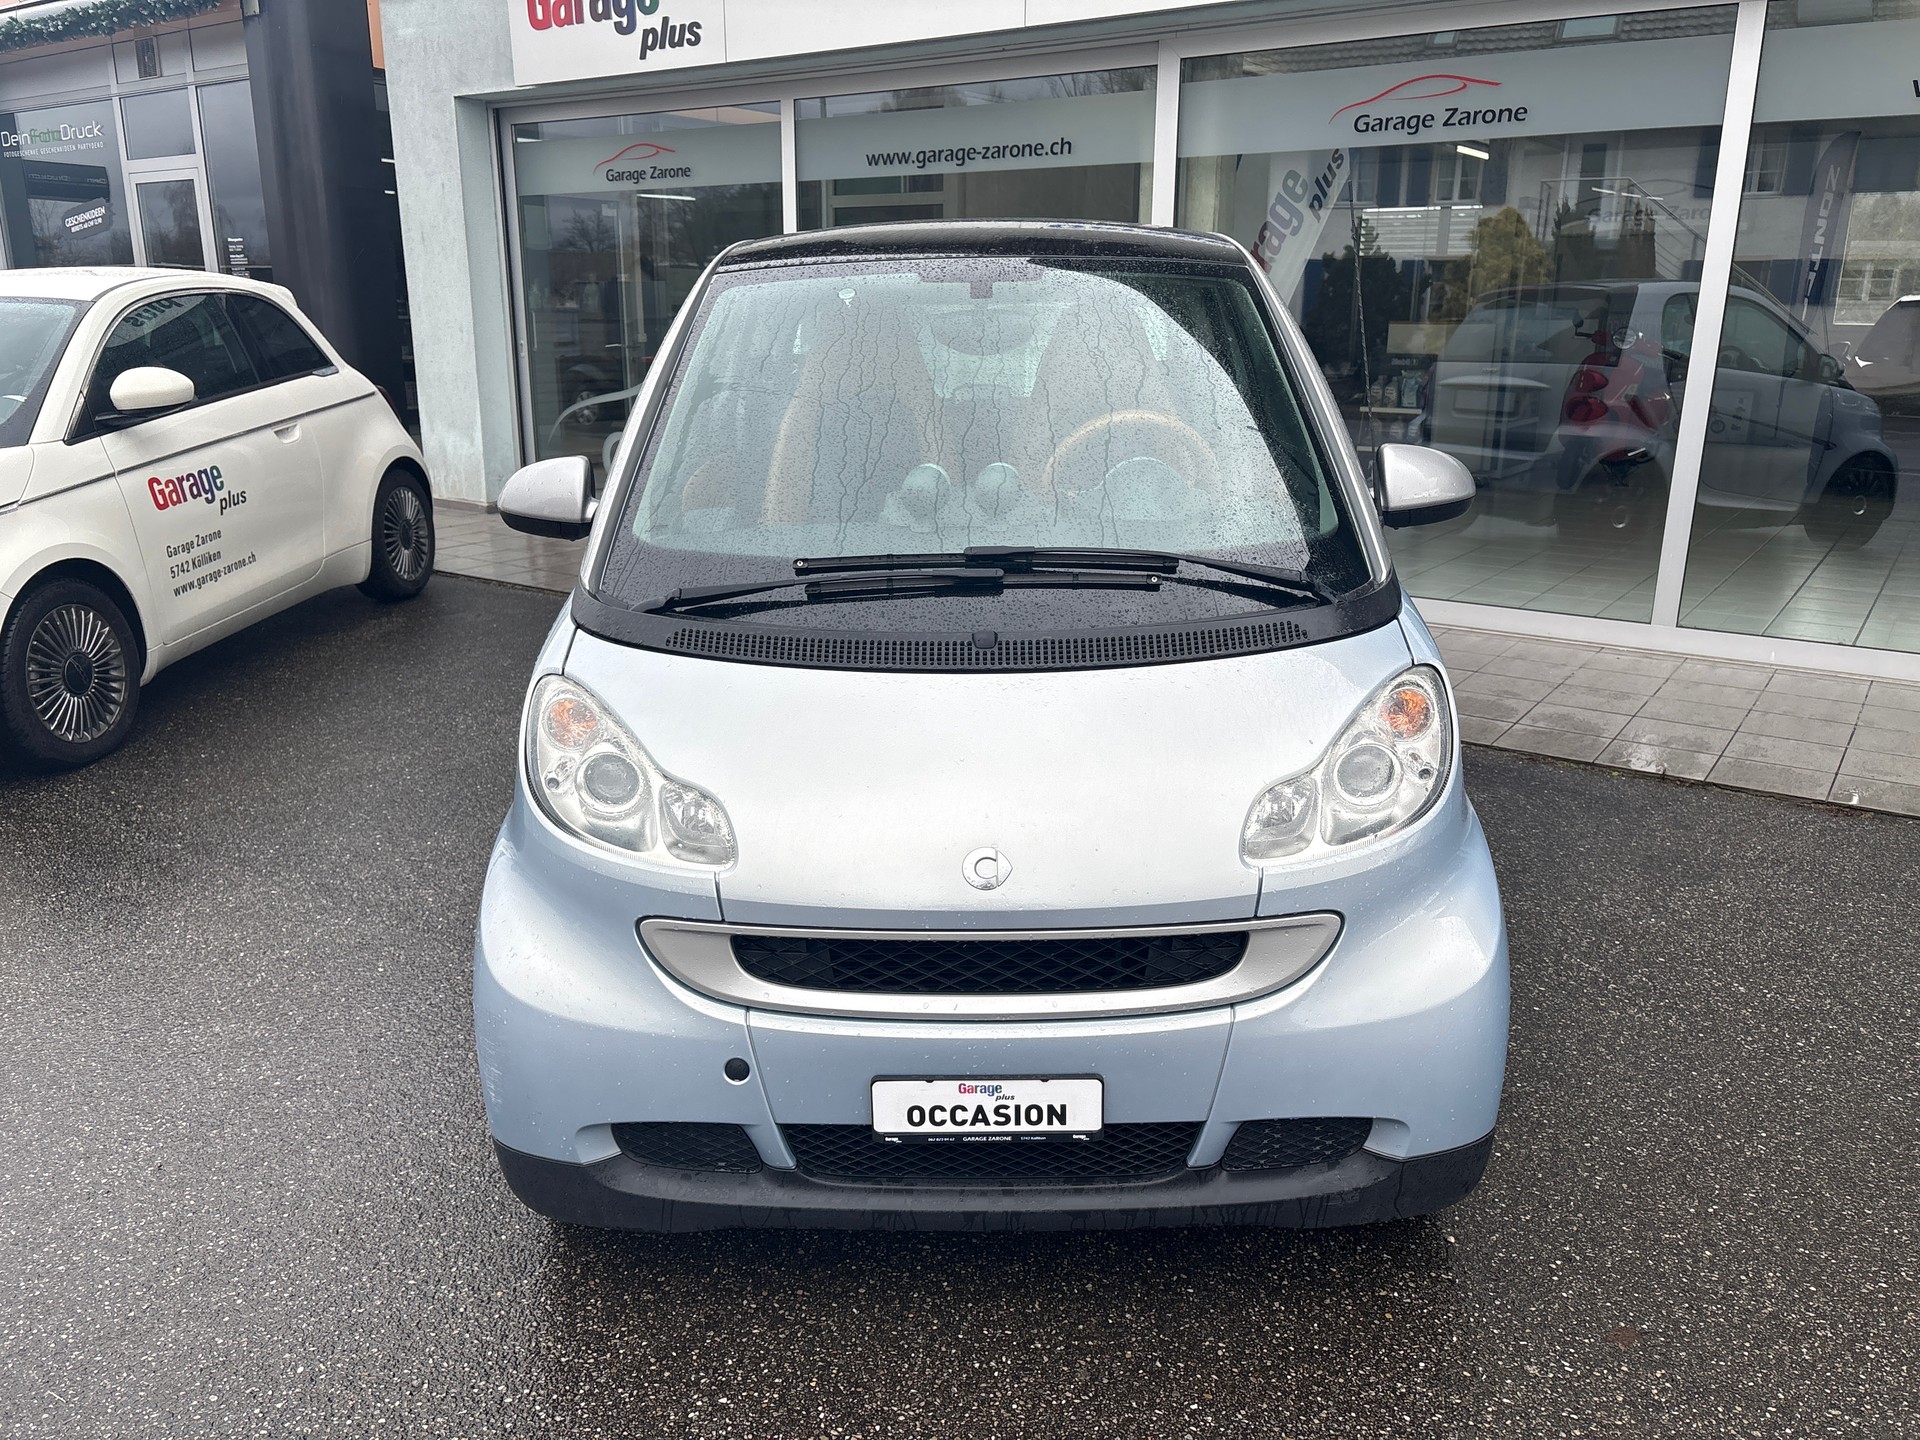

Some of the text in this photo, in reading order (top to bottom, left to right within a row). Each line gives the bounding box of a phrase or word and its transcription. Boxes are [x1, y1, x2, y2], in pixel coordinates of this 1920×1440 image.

[639, 16, 702, 60] plus
[1354, 106, 1528, 135] Garage Zarone
[866, 137, 1073, 168] www.garage-zarone.ch
[606, 166, 691, 184] Garage Zarone
[1309, 148, 1344, 223] plus
[1250, 169, 1308, 275] rage
[147, 464, 225, 511] Garage
[220, 490, 247, 516] plus
[166, 529, 222, 558] Garage Zarone
[170, 551, 222, 579] 5742 Kölliken
[173, 551, 257, 597] www.garage-zarone.ch
[958, 1083, 1002, 1096] Garage
[995, 1094, 1015, 1102] plus
[906, 1103, 1067, 1127] OCCASION
